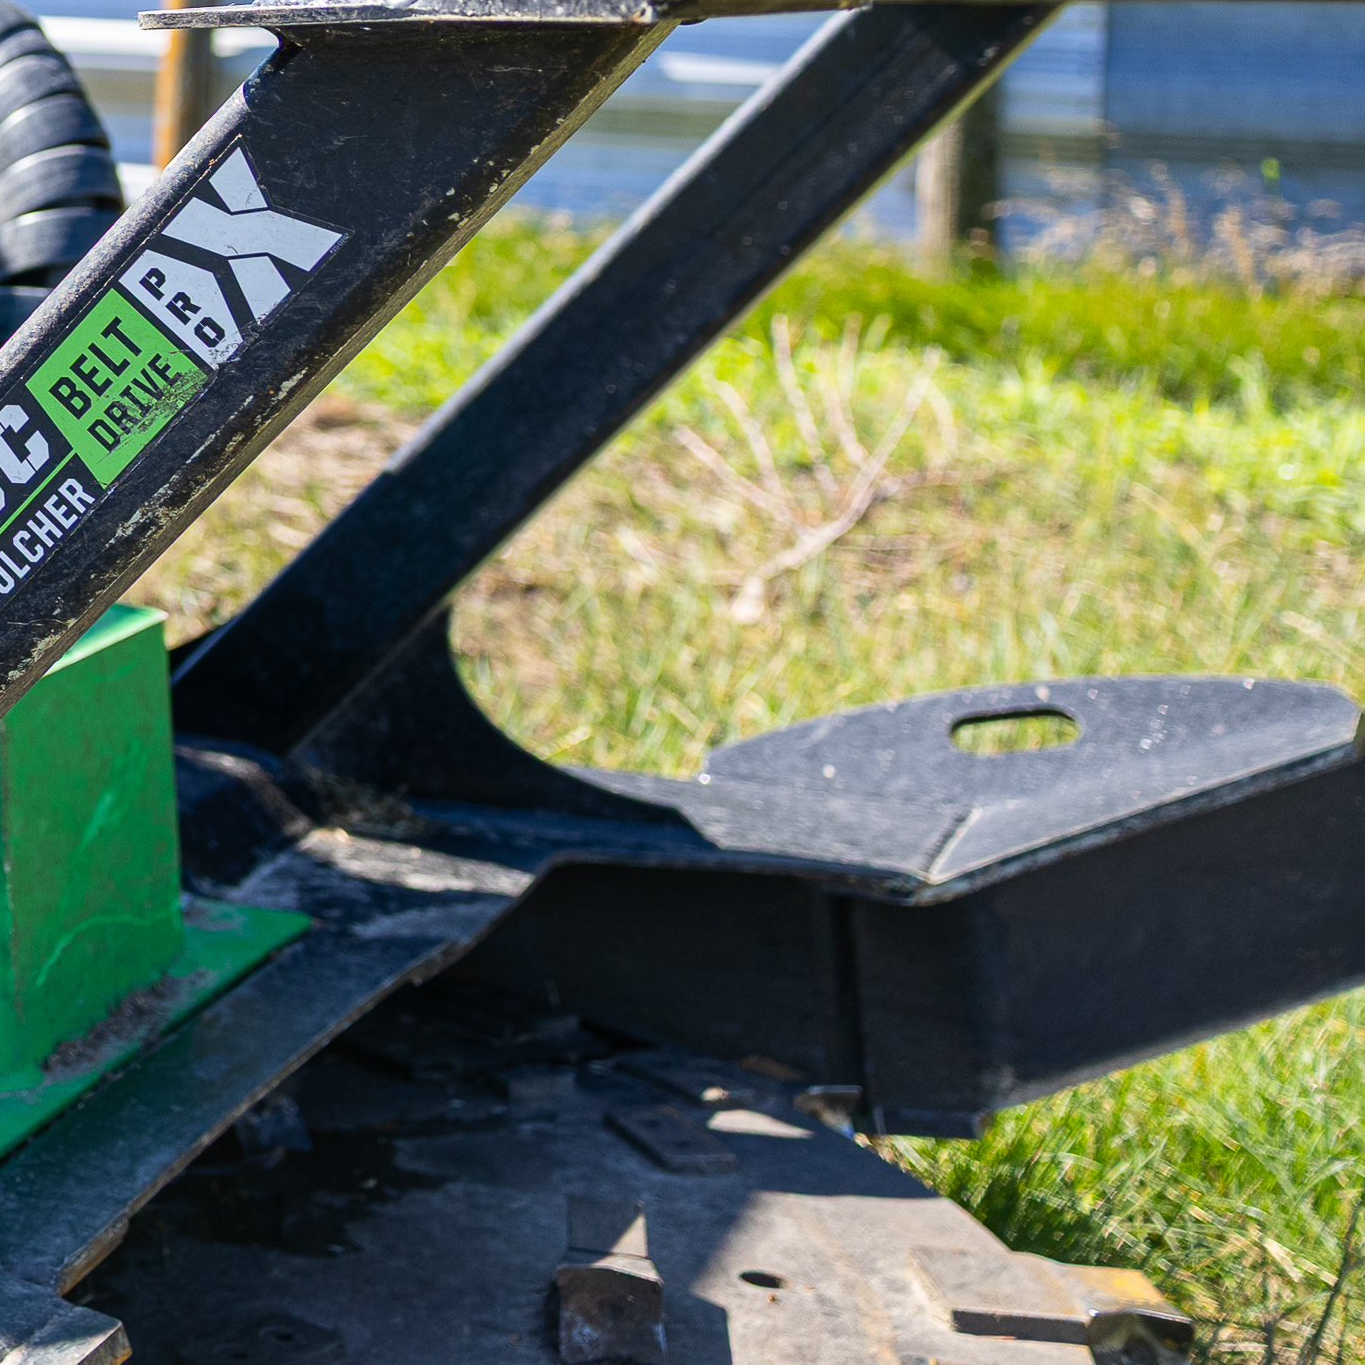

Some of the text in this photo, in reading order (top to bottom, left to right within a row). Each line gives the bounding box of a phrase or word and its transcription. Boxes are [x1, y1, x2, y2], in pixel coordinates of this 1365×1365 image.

[138, 267, 226, 348] PRO
[48, 315, 146, 420] BELT
[86, 350, 185, 455] DRIVE
